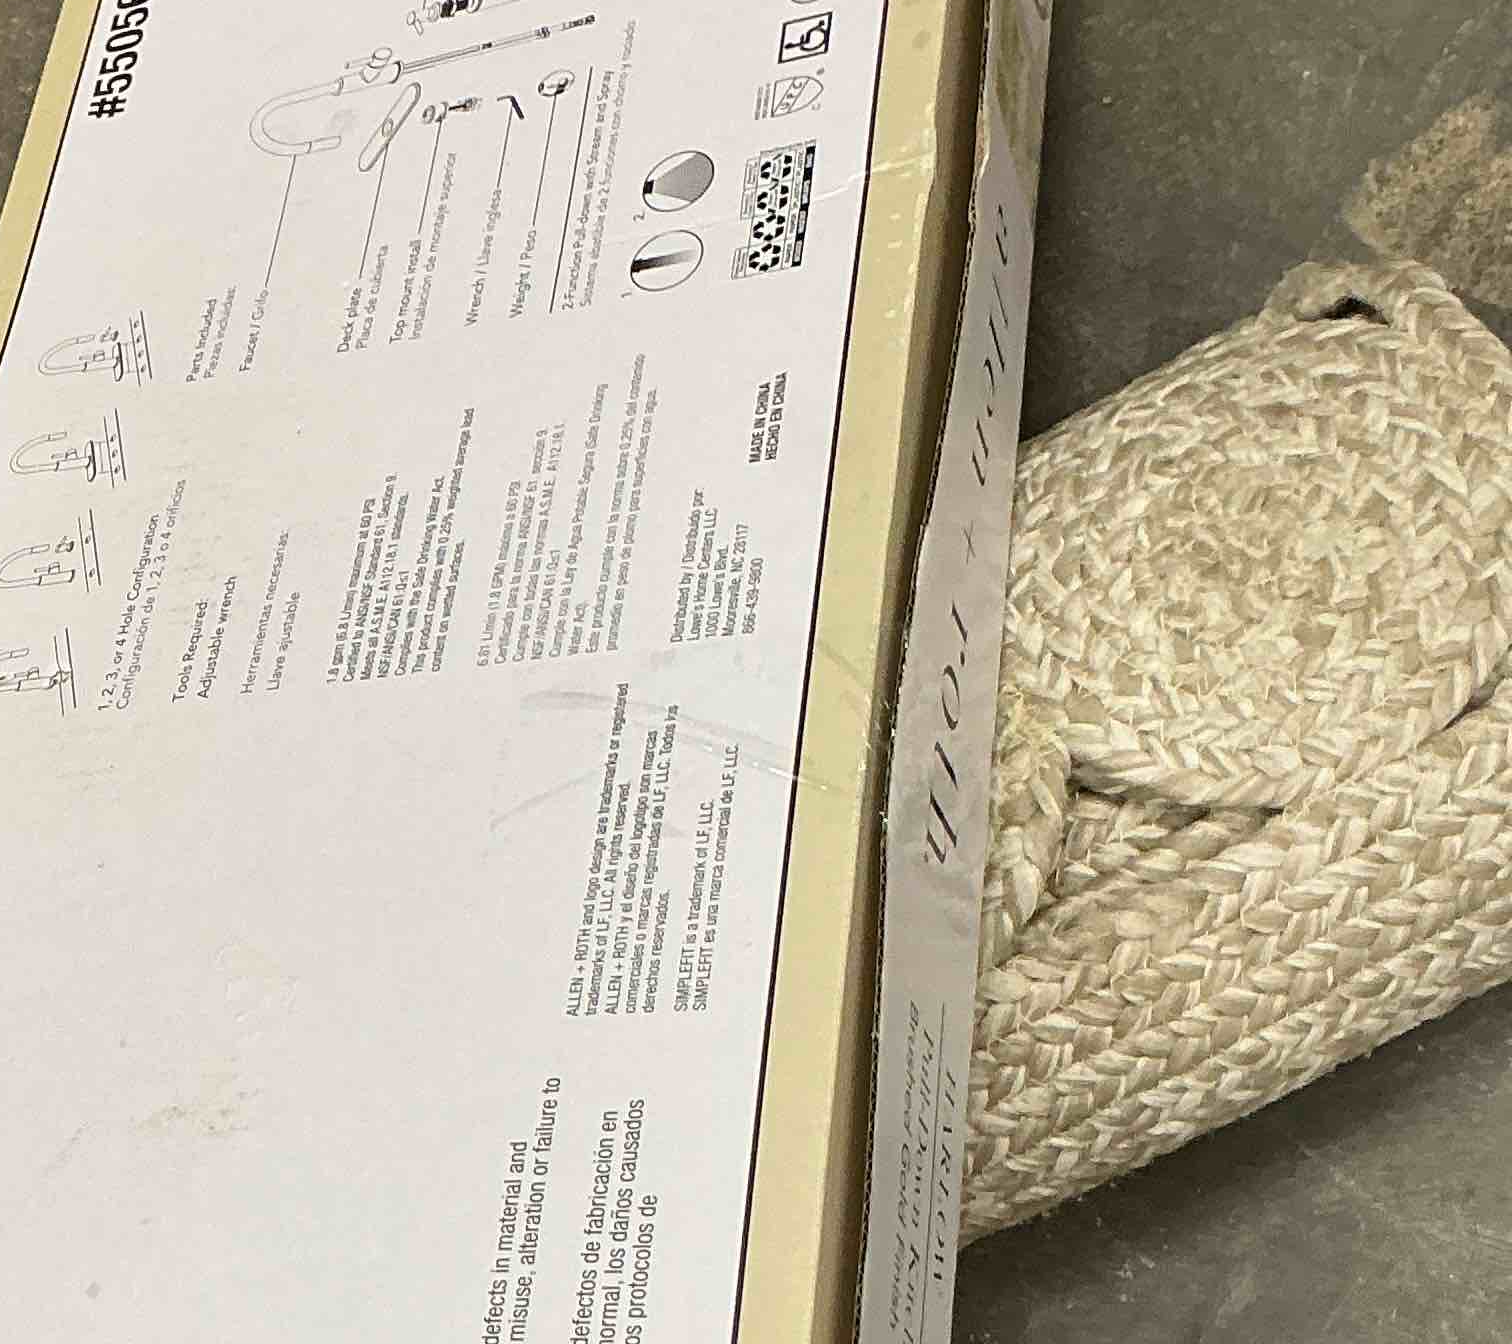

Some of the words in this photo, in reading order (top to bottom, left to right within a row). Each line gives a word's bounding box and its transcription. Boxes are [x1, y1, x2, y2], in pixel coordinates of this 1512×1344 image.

[344, 287, 362, 317] plate
[336, 320, 355, 352] Deck
[755, 381, 771, 415] CHINA
[771, 371, 787, 405] CHINA
[753, 416, 766, 428] IN
[769, 406, 783, 422] EN
[748, 429, 765, 463] MADE
[764, 423, 781, 460] HECHO
[703, 507, 718, 528] LLC
[696, 529, 715, 570] Centers
[732, 523, 749, 554] 28117
[729, 555, 745, 572] NC
[692, 571, 709, 602] Home
[686, 603, 705, 640] Lowe's
[720, 574, 743, 636] Mooresville,
[181, 598, 208, 661] Required:
[197, 626, 225, 698] Adjustable
[218, 575, 237, 623] wrench
[171, 664, 193, 703] Tools
[903, 999, 919, 1138] Brushed
[509, 1140, 528, 1172] and
[897, 1142, 911, 1229] Gold
[498, 1178, 522, 1250] material
[490, 1256, 510, 1272] in
[888, 1232, 905, 1331] Finish
[481, 1279, 510, 1344] defects
